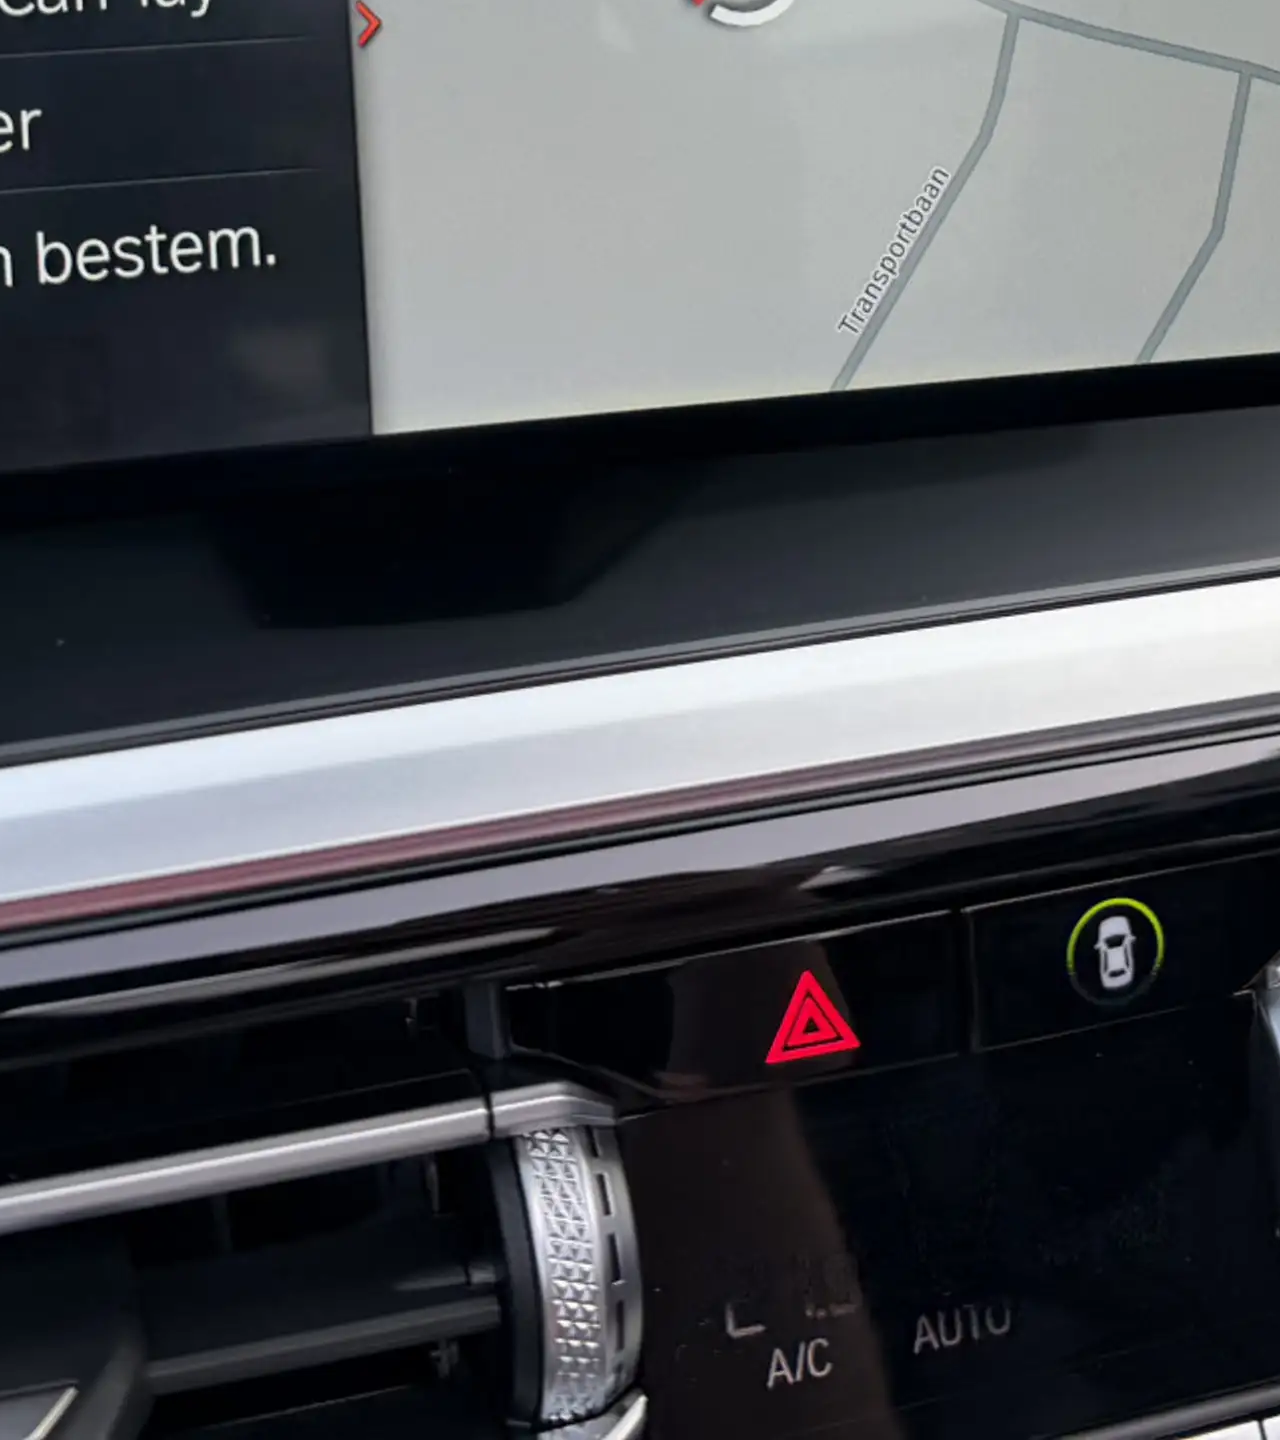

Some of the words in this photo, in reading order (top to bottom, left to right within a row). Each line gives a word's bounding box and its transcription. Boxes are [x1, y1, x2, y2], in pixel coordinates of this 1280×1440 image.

[36, 222, 278, 287] bestem.
[838, 166, 950, 337] Transportbaan
[913, 1303, 1012, 1354] AUTO
[766, 1337, 833, 1389] A/C
